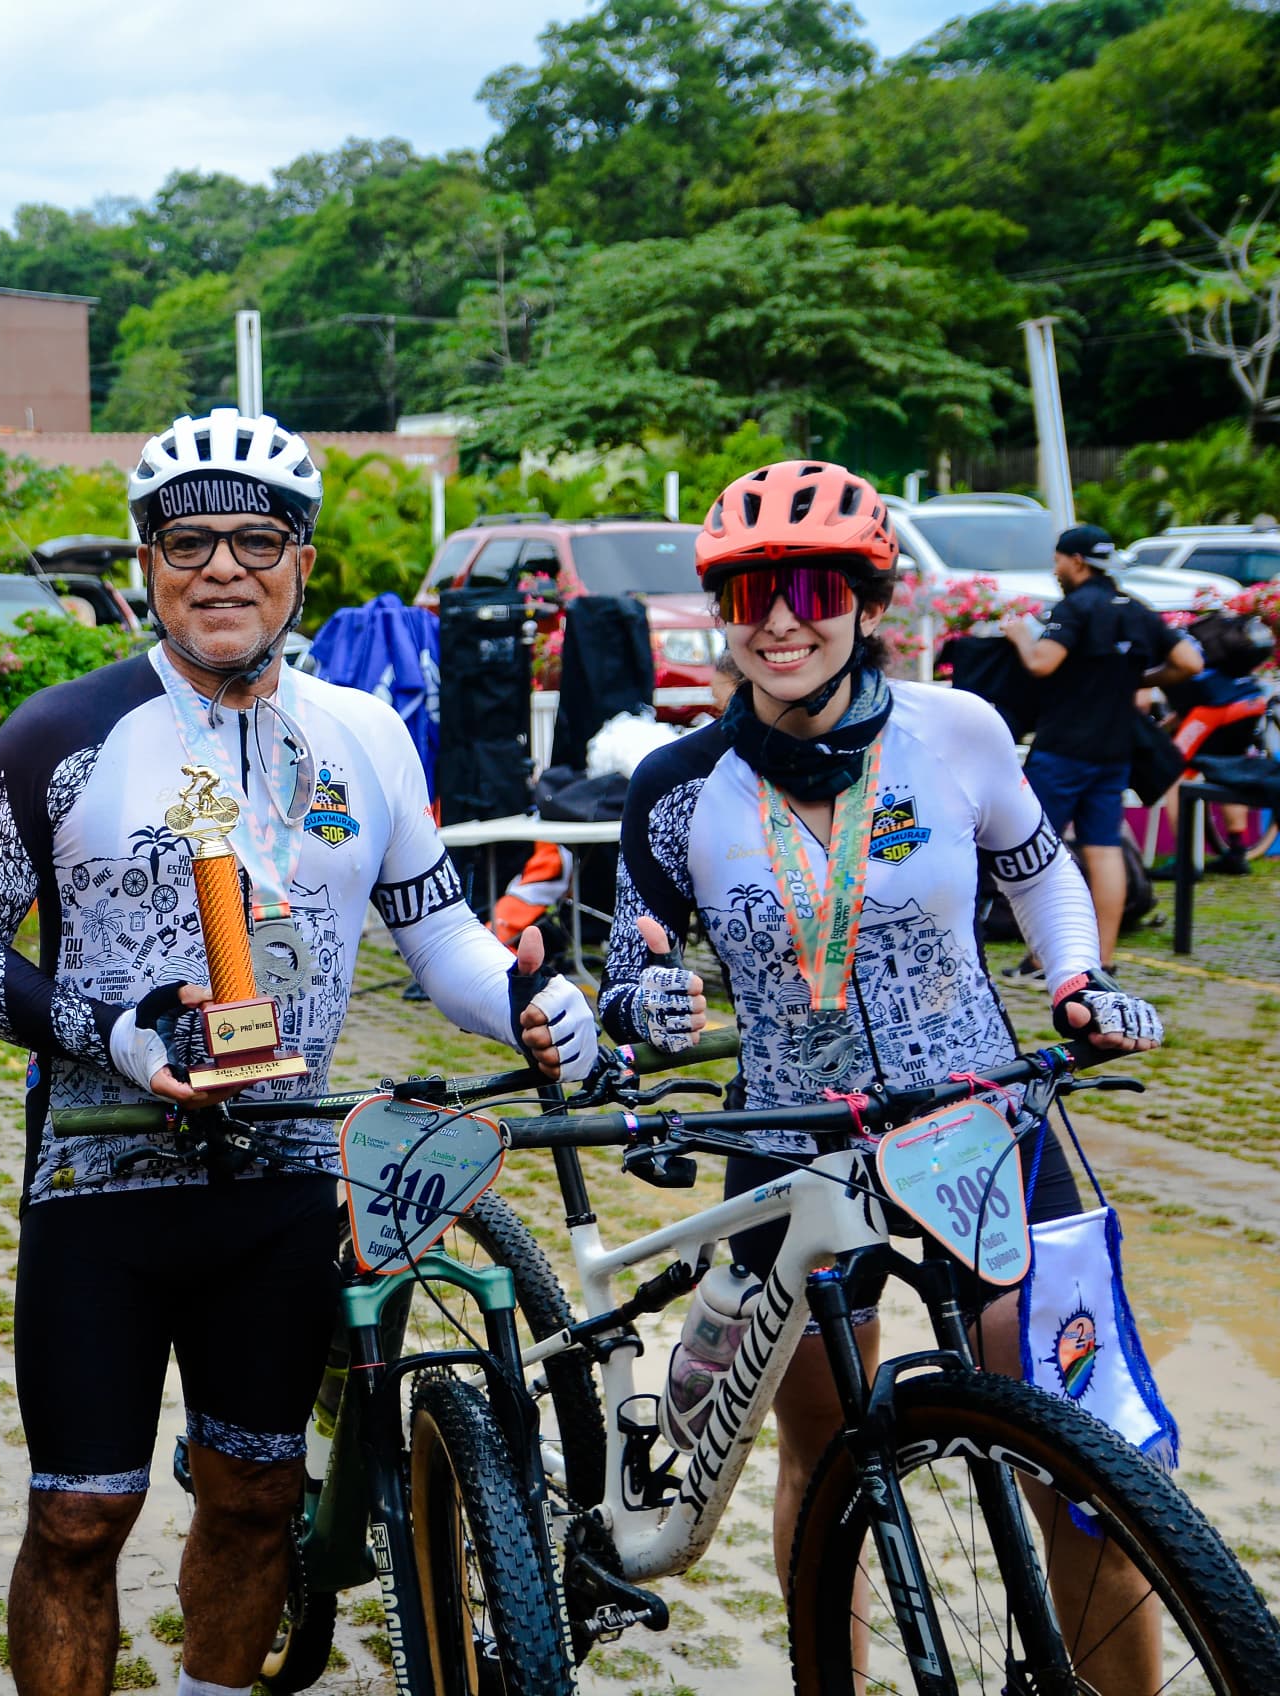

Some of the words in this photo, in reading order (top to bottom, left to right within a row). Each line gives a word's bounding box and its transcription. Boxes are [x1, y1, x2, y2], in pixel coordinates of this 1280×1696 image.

[158, 480, 271, 518] GUAYMURAS
[304, 816, 358, 833] GUAYMURAS
[322, 826, 345, 843] 506
[870, 832, 926, 850] UAYMURAS
[178, 855, 189, 866] YO
[883, 843, 911, 861] 506
[92, 866, 114, 888] BIKE
[167, 865, 192, 876] ESTUV
[785, 869, 814, 920] 2022
[759, 914, 786, 923] ESTUVE
[766, 906, 777, 915] YO
[62, 921, 74, 936] ON
[65, 938, 83, 952] DU
[116, 933, 140, 953] BIKE
[131, 935, 157, 970] EXTREMO
[825, 938, 848, 966] FA
[64, 954, 83, 969] RAS
[907, 964, 929, 977] BIKE
[311, 976, 328, 986] BIKE
[255, 1021, 273, 1030] BIKES
[240, 1062, 280, 1072] LUGAR
[901, 1058, 929, 1072] VIVE
[910, 1070, 926, 1082] TU
[271, 1080, 295, 1091] VIVE
[320, 1093, 376, 1106] RITCH
[404, 1114, 430, 1126] POINT
[420, 1111, 439, 1131] 2
[352, 1132, 367, 1147] FA
[366, 1162, 446, 1225] 210
[935, 1166, 1010, 1237] 308
[380, 1224, 408, 1242] Cars
[367, 1242, 406, 1261] Espinoa
[679, 1266, 795, 1526] SPECIALIZED
[839, 1486, 864, 1526] NTROL
